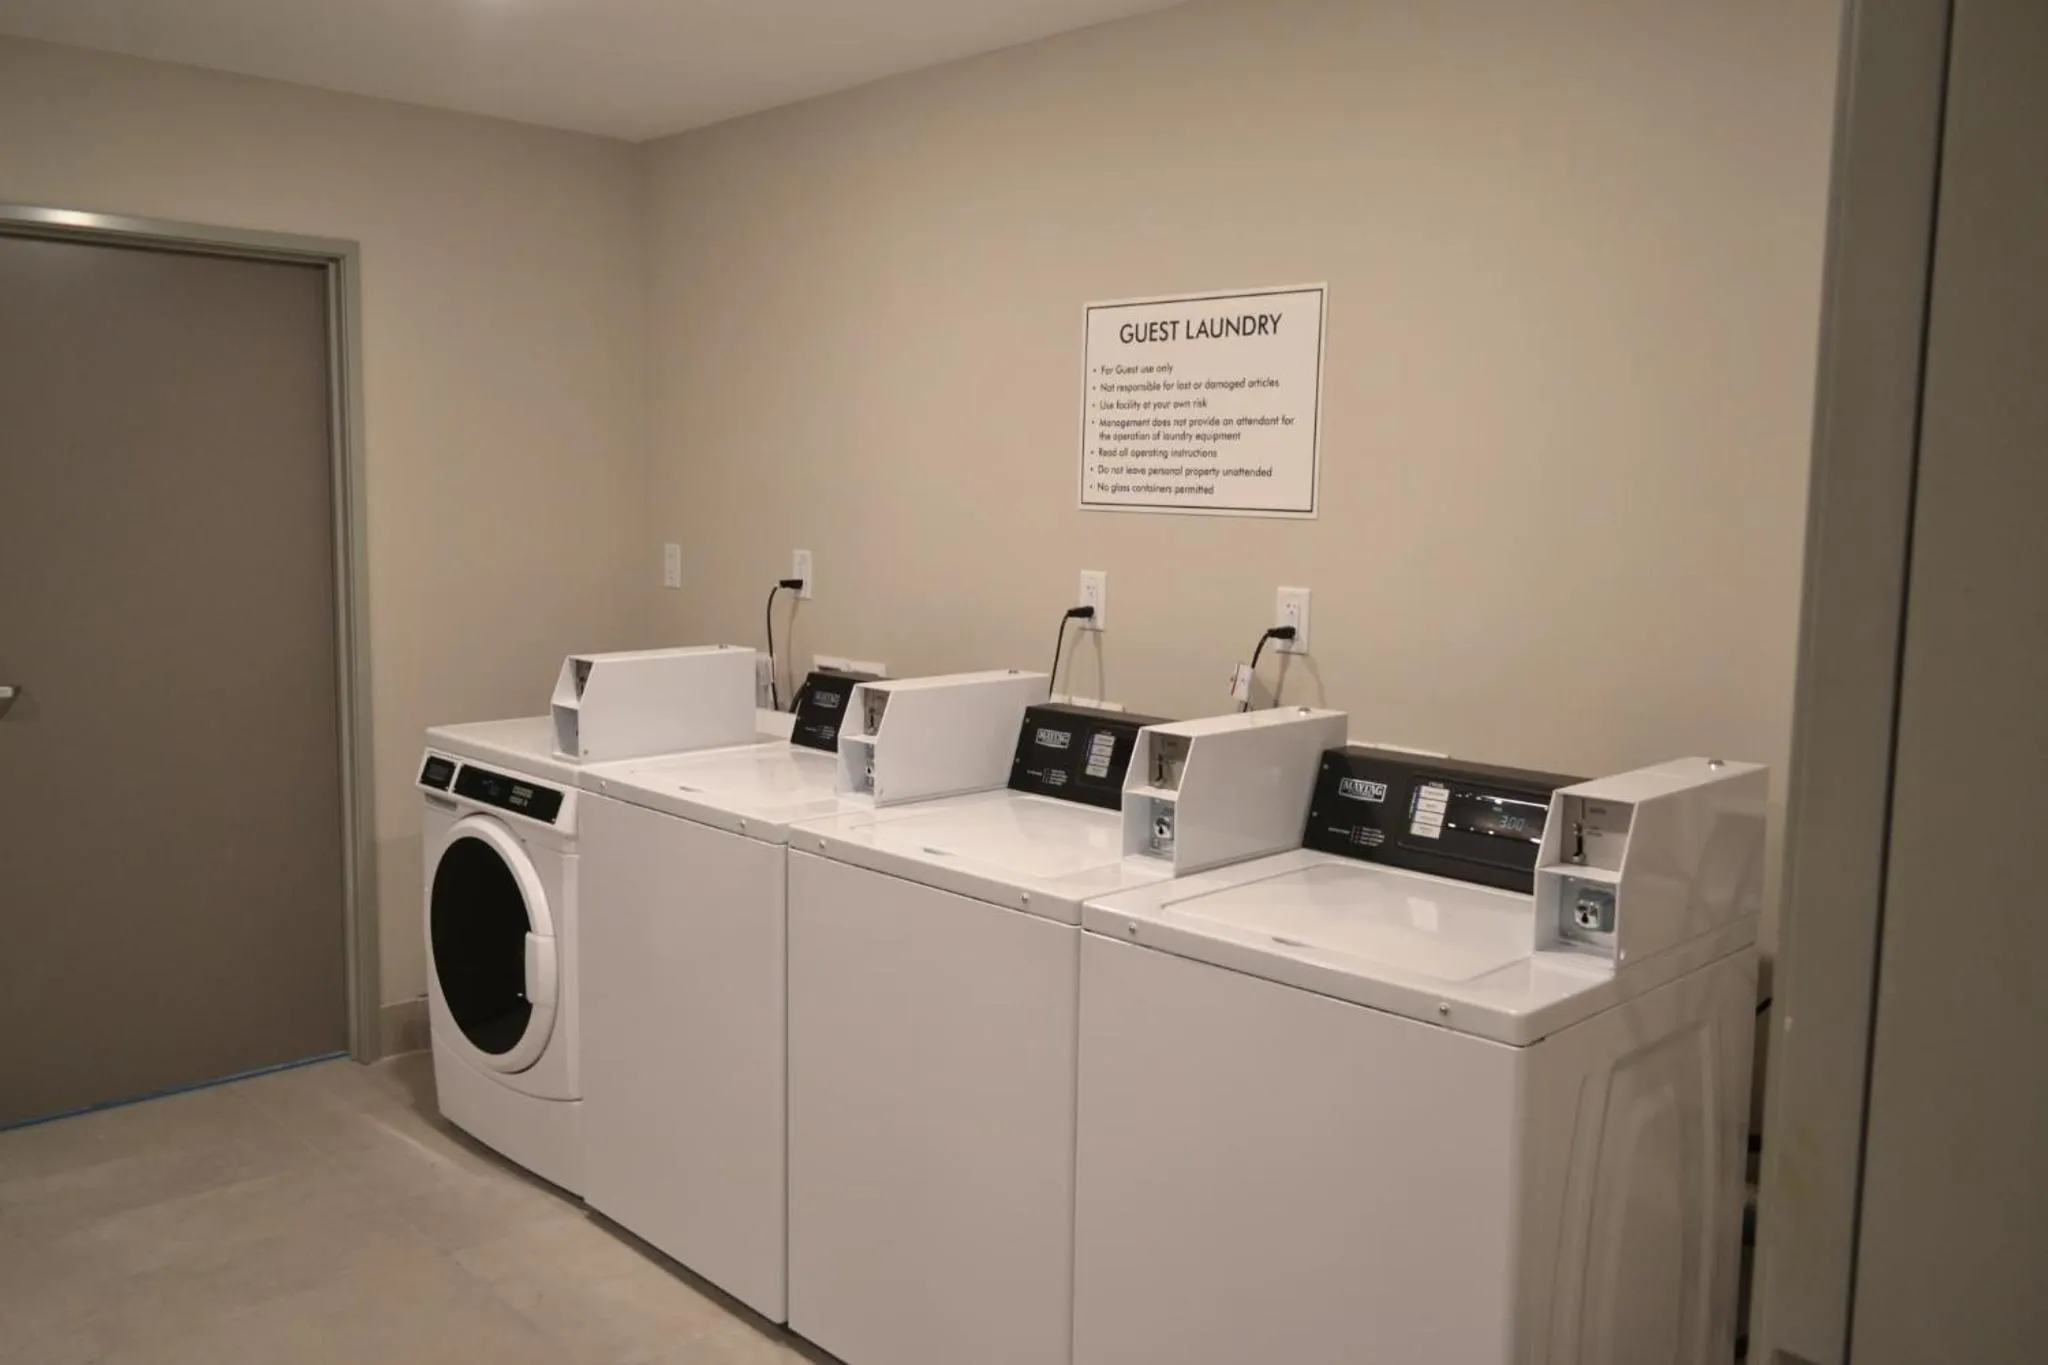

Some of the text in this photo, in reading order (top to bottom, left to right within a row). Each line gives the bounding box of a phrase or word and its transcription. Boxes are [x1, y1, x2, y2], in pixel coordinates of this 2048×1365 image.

[1120, 313, 1282, 344] GUEST LAUNDRY
[1101, 362, 1173, 375] For Guest use only
[1100, 376, 1280, 393] Not responsible for lost or damaged articles
[1100, 397, 1207, 411] Use facility at your own risk
[1099, 415, 1295, 429] Management does not provide an attendant for
[1099, 430, 1241, 444] the operation of laundry equipment
[1098, 447, 1217, 459] Read all operating instructions
[1097, 464, 1273, 478] Do not leave personal property unattended
[1097, 482, 1214, 495] No glass containers permitted
[1340, 778, 1386, 800] MAYTAG
